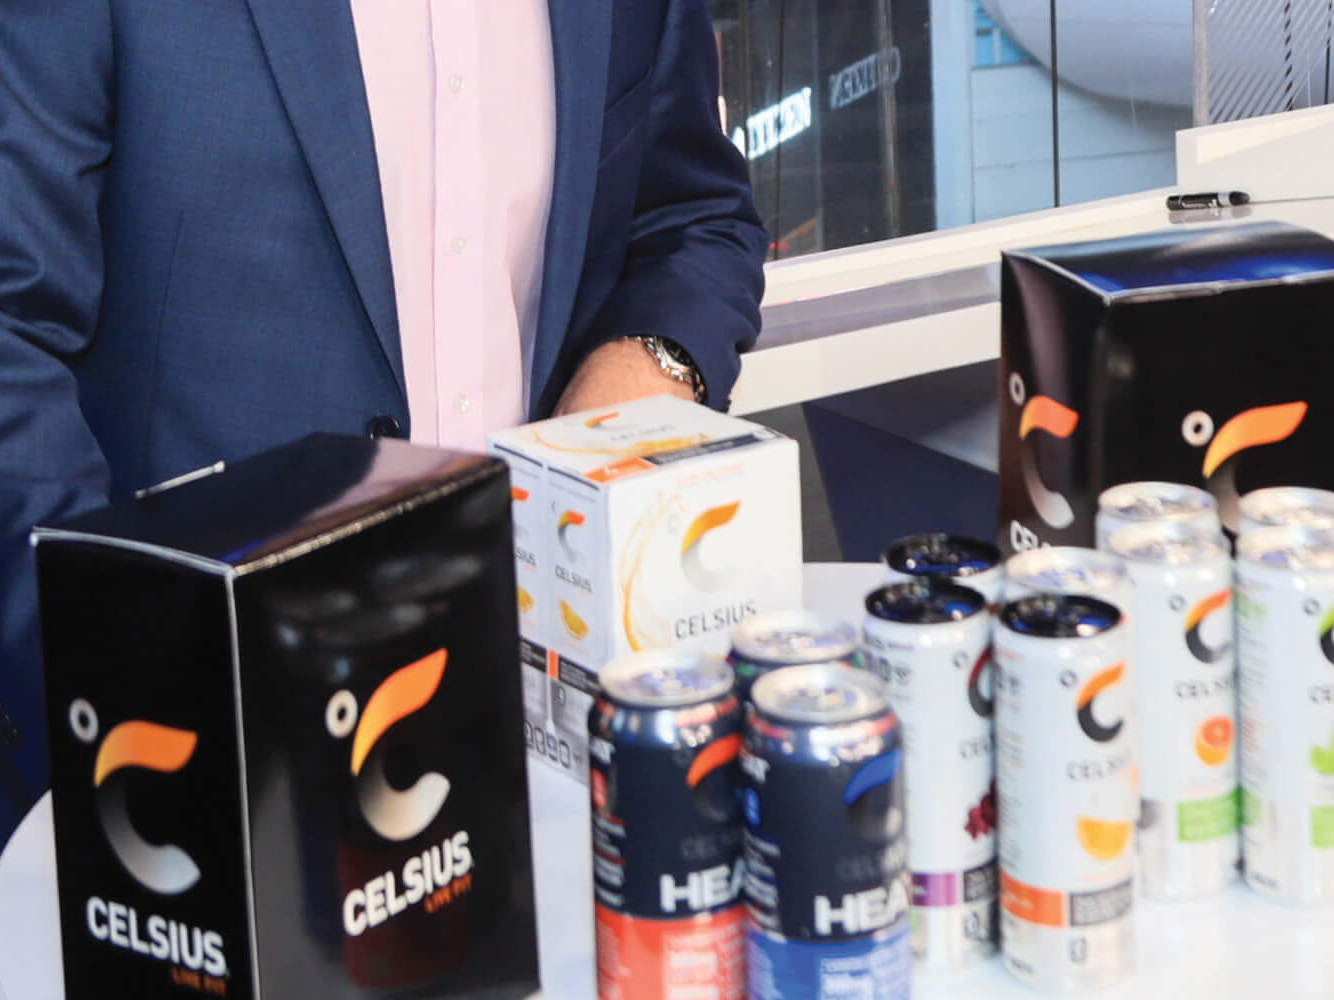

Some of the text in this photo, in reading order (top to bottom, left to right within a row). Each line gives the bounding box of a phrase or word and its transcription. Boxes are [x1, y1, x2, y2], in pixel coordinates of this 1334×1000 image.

[674, 600, 758, 642] CELSIUS
[343, 830, 476, 937] CELSIUS
[86, 895, 230, 978] CELSIUS
